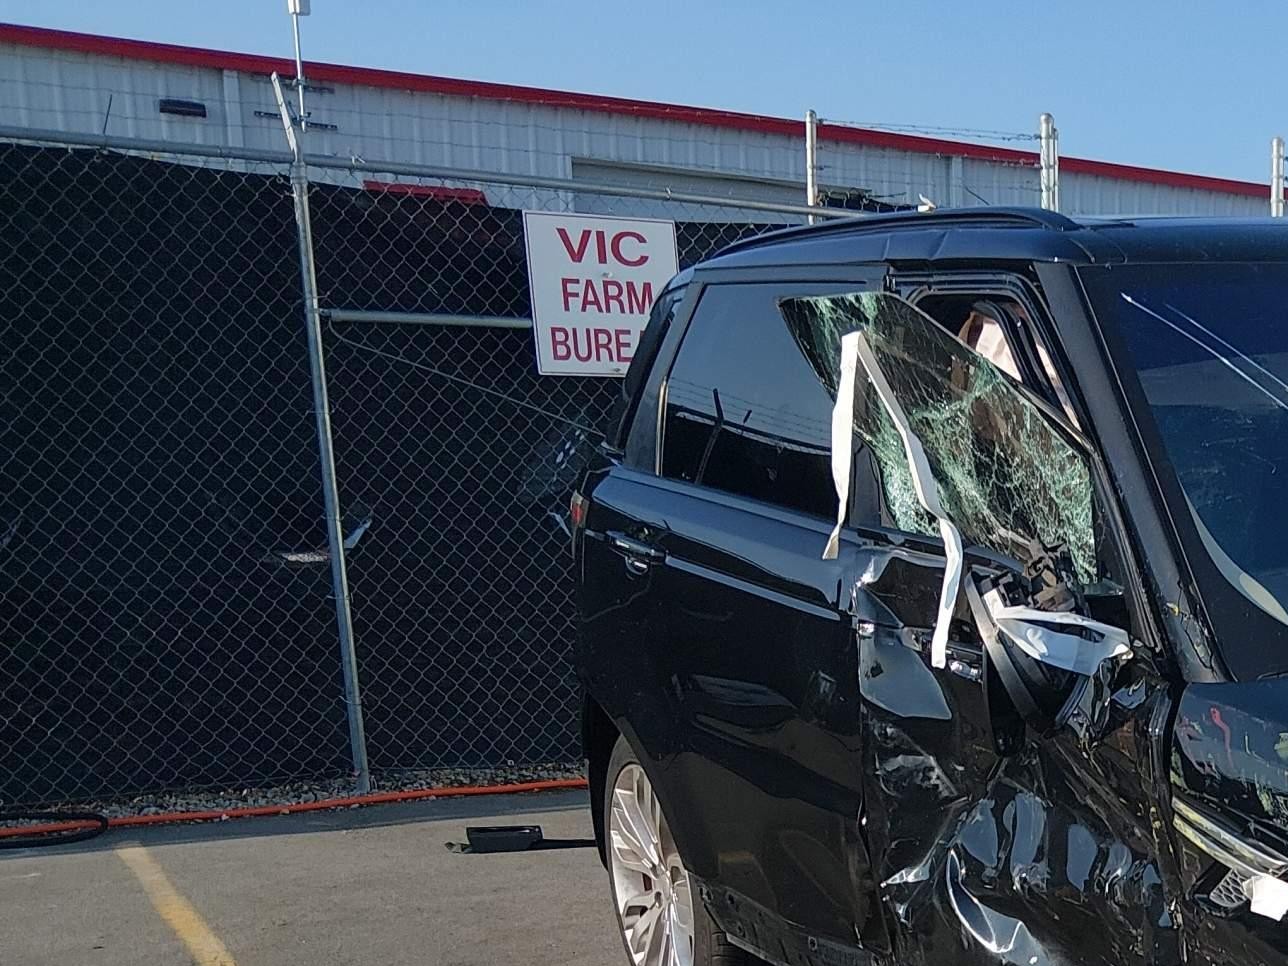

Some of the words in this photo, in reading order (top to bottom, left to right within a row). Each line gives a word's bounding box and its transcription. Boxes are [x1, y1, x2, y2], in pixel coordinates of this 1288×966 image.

[555, 227, 650, 267] VIC
[560, 277, 654, 316] FARM
[549, 326, 647, 364] BURE
